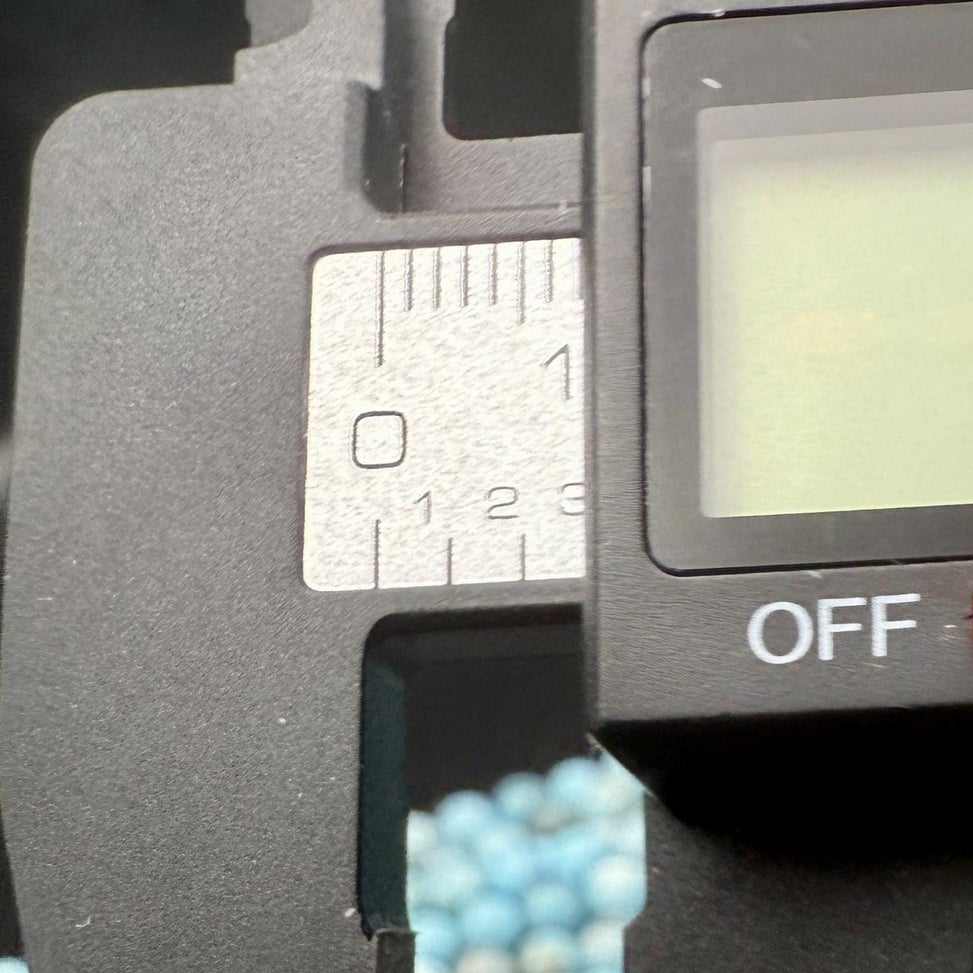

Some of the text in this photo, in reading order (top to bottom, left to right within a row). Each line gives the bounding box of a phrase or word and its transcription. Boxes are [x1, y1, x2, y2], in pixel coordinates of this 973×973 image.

[539, 342, 571, 402] 1
[411, 489, 433, 525] 1
[485, 484, 521, 521] 2
[746, 592, 922, 665] OFF
